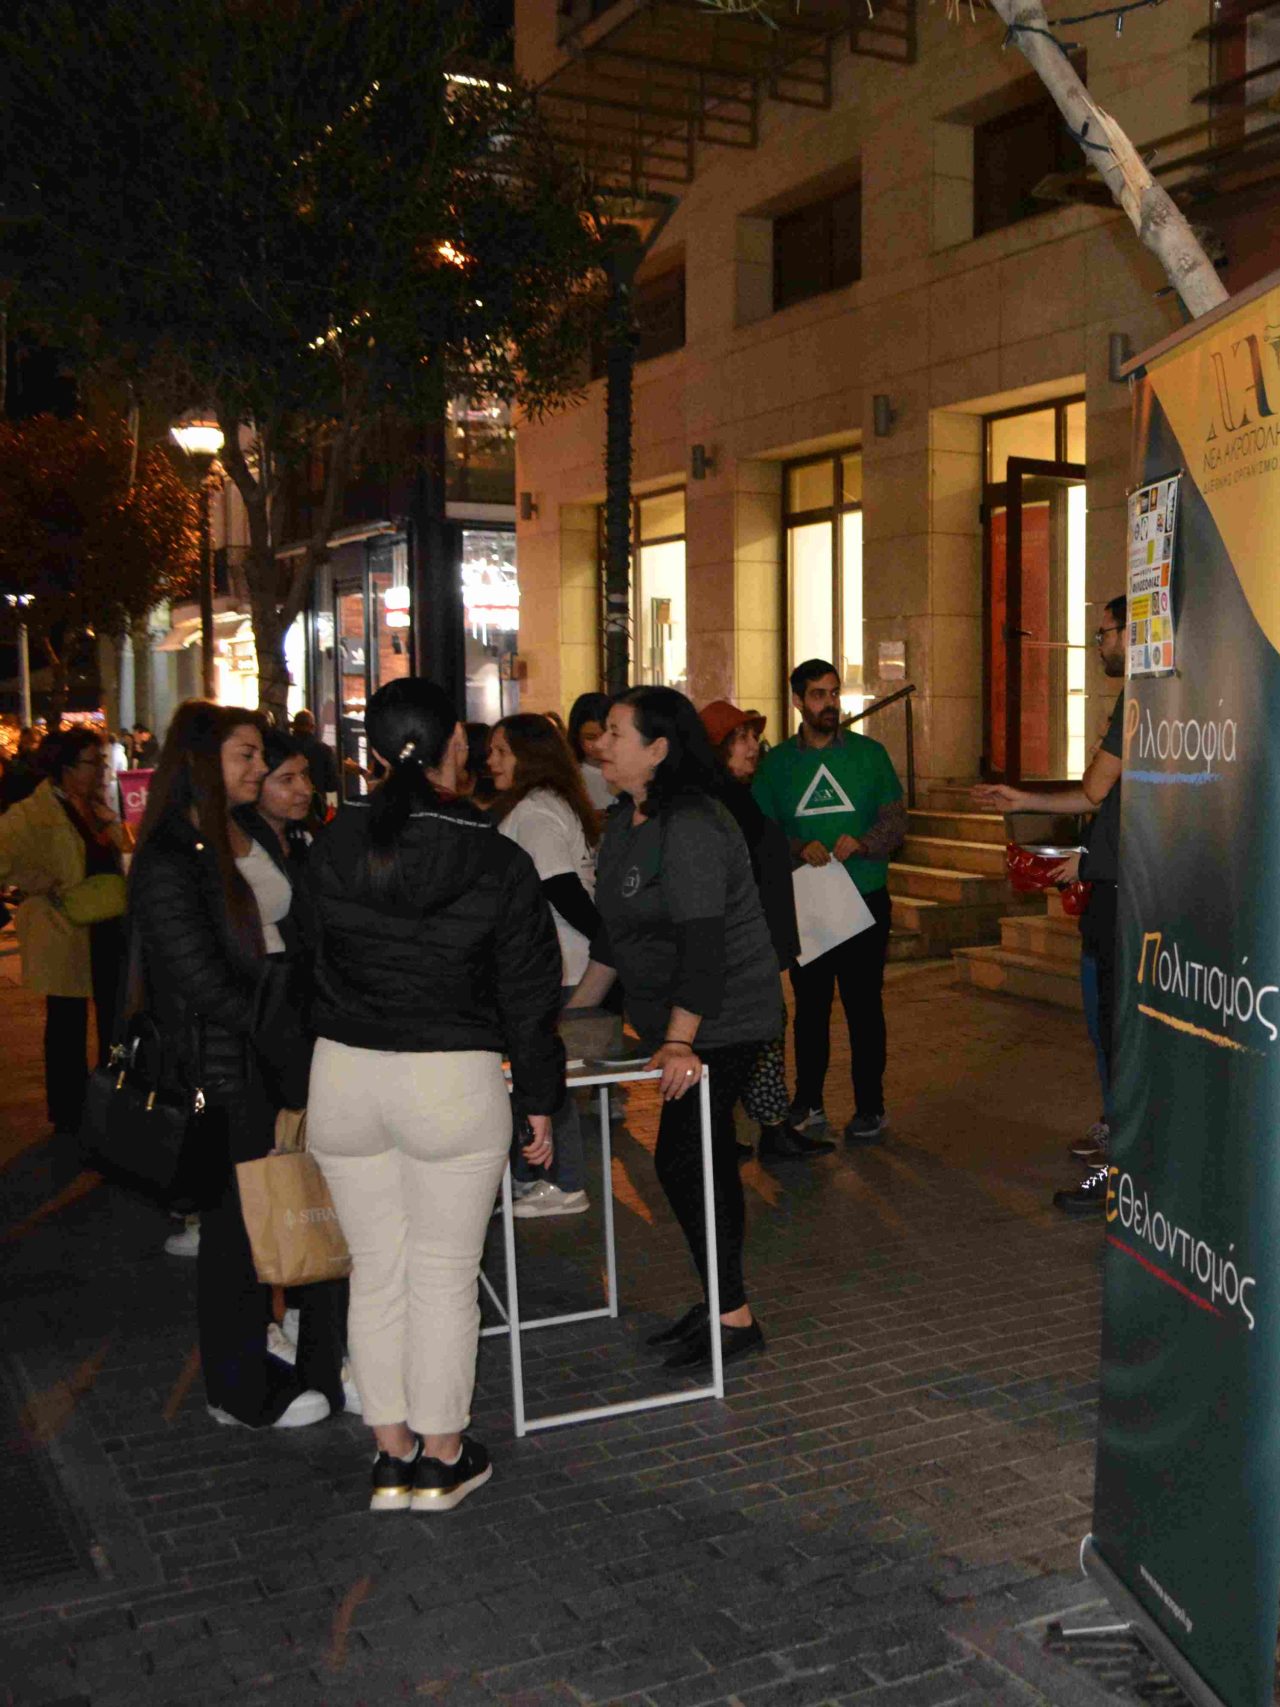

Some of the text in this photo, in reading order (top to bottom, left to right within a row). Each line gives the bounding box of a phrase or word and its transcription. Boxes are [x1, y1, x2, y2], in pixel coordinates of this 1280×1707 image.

[1203, 447, 1221, 472] ΝΕΑ
[1137, 931, 1279, 1041] Πολιτισμός
[1106, 1166, 1256, 1331] Εθελοντισμός
